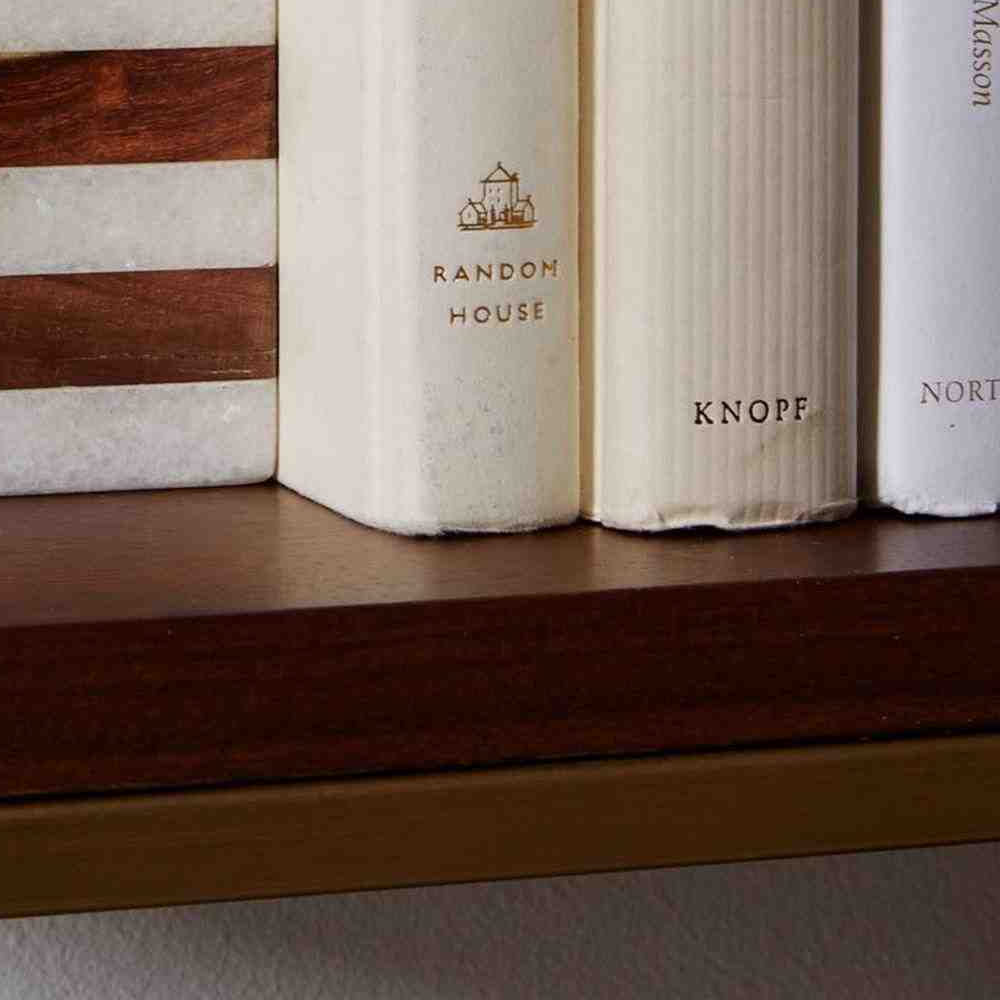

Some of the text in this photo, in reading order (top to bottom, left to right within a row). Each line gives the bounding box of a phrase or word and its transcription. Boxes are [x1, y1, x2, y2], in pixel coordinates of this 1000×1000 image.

[433, 259, 557, 282] RANDOM
[449, 301, 543, 324] HOUSE
[920, 379, 1000, 403] NORT
[694, 397, 807, 424] KNOPF
